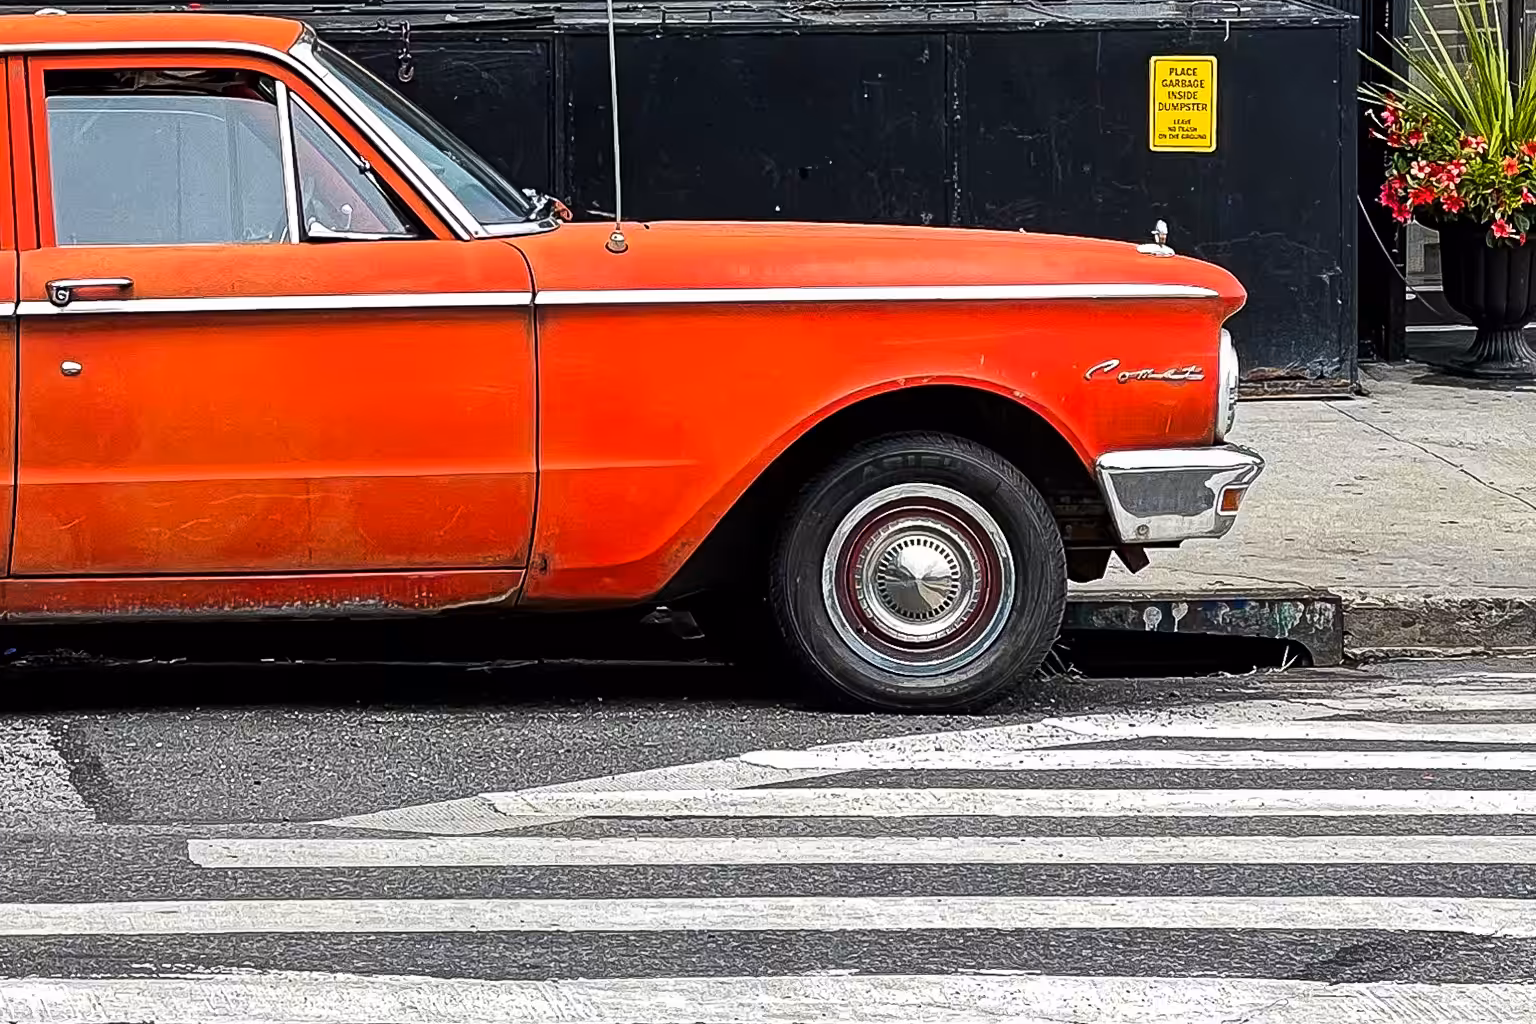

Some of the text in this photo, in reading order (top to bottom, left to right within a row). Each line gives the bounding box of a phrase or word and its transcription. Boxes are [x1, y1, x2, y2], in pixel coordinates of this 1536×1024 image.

[1169, 67, 1198, 77] PLACE
[1161, 79, 1206, 89] GARBAGE
[1167, 90, 1199, 100] INSIDE
[1158, 102, 1208, 112] DUMPSTER
[1084, 358, 1205, 383] Comet
